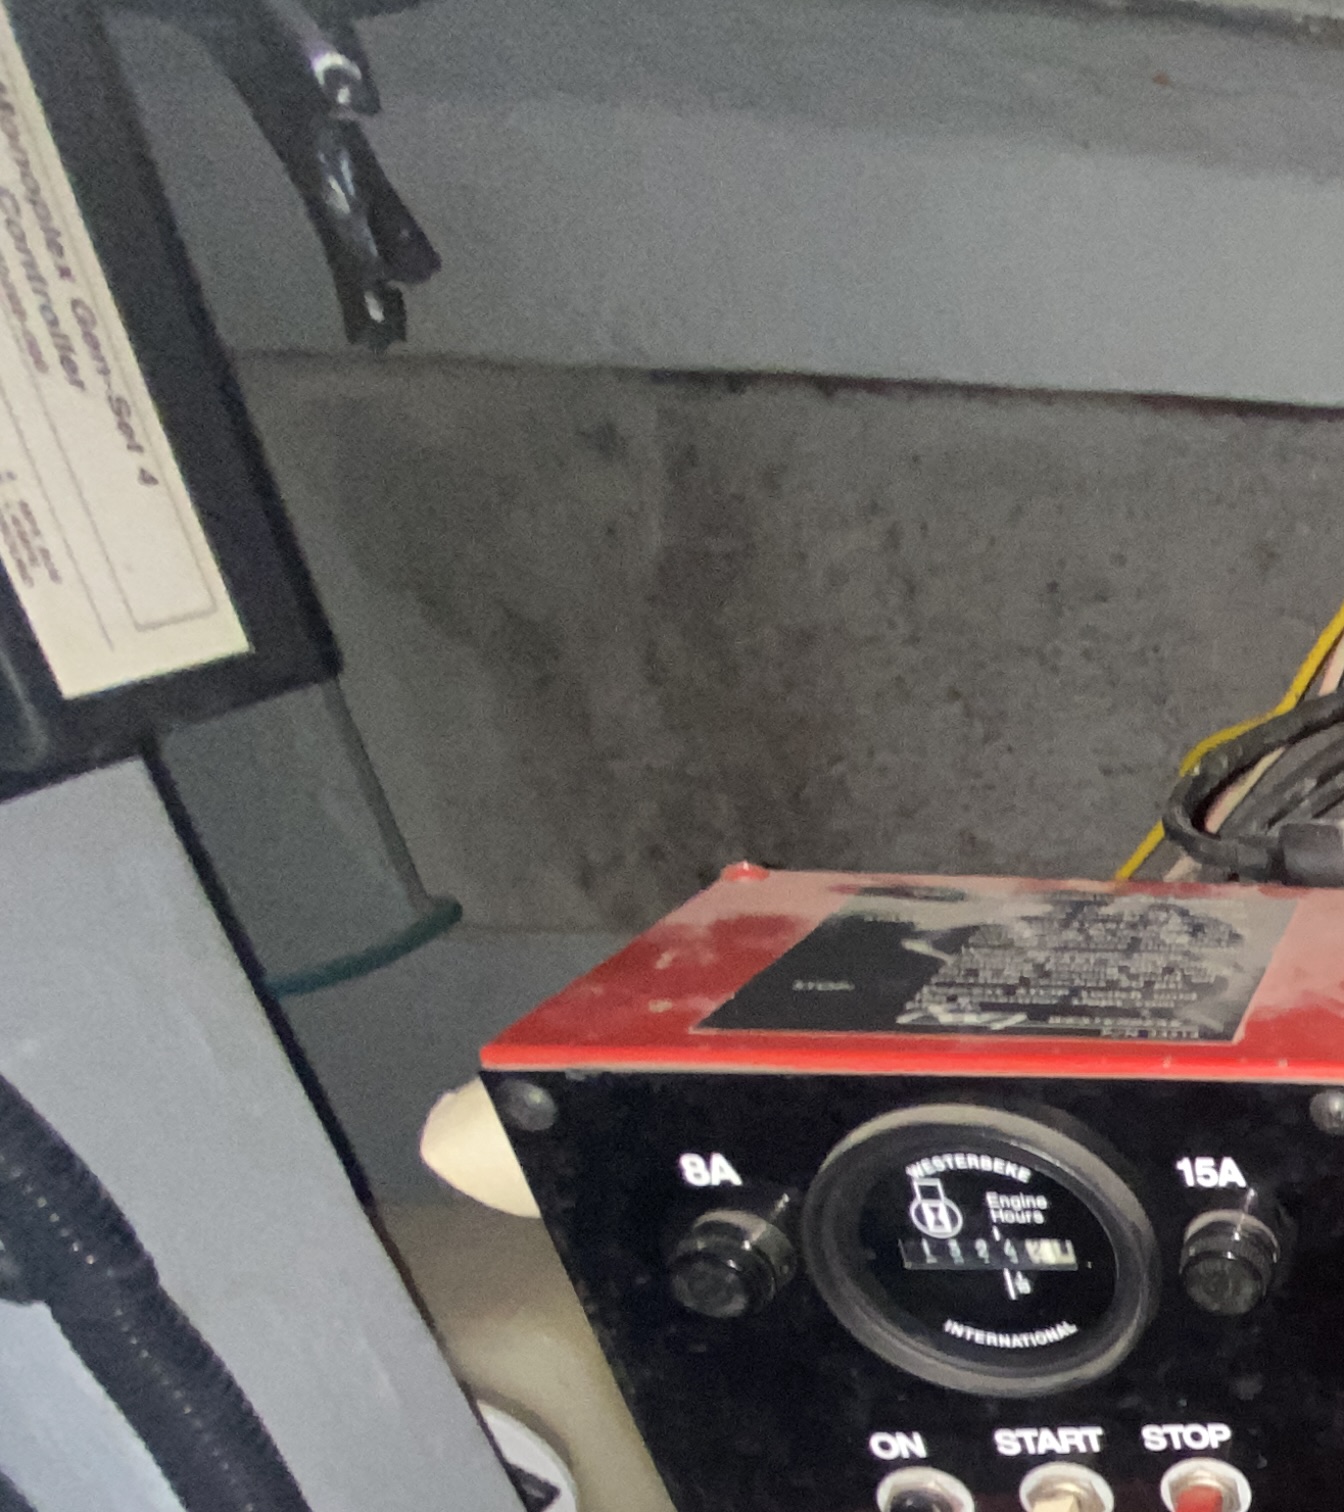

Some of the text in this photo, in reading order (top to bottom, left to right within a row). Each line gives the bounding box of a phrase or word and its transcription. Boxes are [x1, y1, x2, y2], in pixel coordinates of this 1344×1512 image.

[679, 1152, 743, 1187] 8A
[905, 1153, 1031, 1184] WESTERBEKE
[1176, 1156, 1247, 1188] 15A
[986, 1191, 1047, 1210] Engine
[990, 1208, 1045, 1224] Hours
[943, 1319, 1078, 1348] INTERNATIONAL
[869, 1432, 927, 1460] ON
[994, 1426, 1104, 1456] START
[1142, 1423, 1231, 1451] STOP
